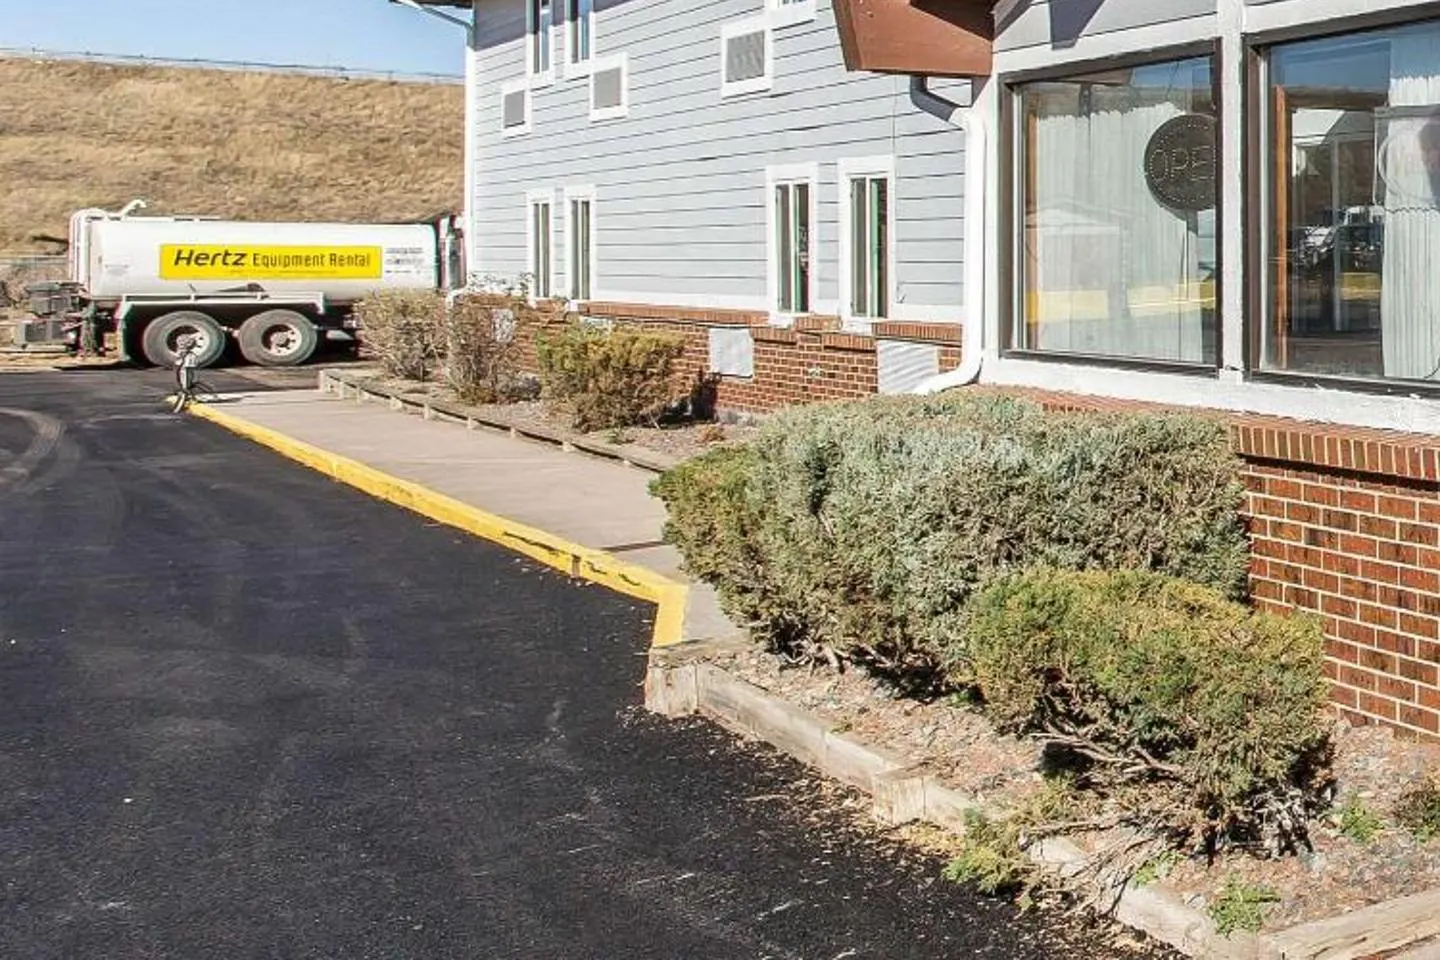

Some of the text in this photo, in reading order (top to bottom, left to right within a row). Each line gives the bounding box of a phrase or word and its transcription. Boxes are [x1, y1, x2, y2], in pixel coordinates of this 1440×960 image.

[1150, 145, 1217, 182] OPE
[173, 249, 248, 267] Hertz
[253, 253, 325, 268] Equipment
[329, 253, 371, 267] Rental
